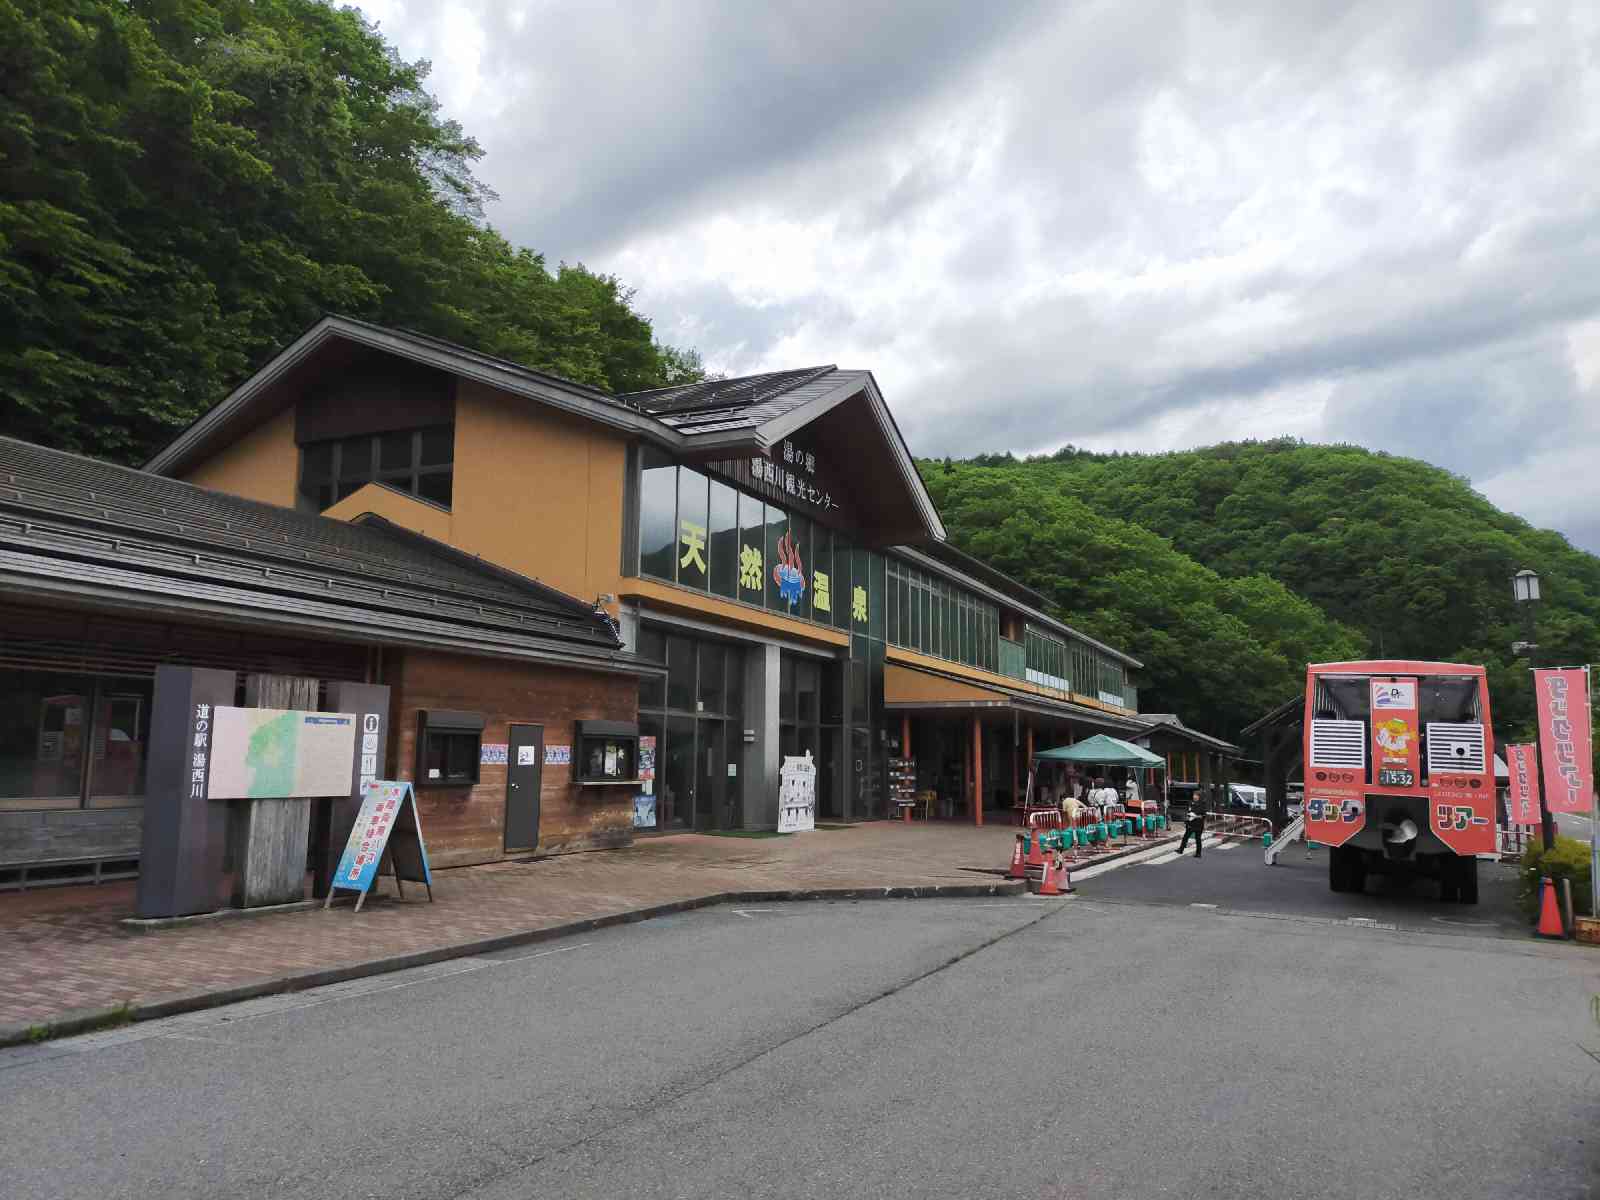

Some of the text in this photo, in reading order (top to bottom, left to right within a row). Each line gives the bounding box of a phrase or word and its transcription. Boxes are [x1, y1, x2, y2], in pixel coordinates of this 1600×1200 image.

[751, 457, 840, 512] 湯西川観光センター
[190, 704, 210, 798] 道の駅 湯西川
[1308, 798, 1490, 830] ダック ツアー
